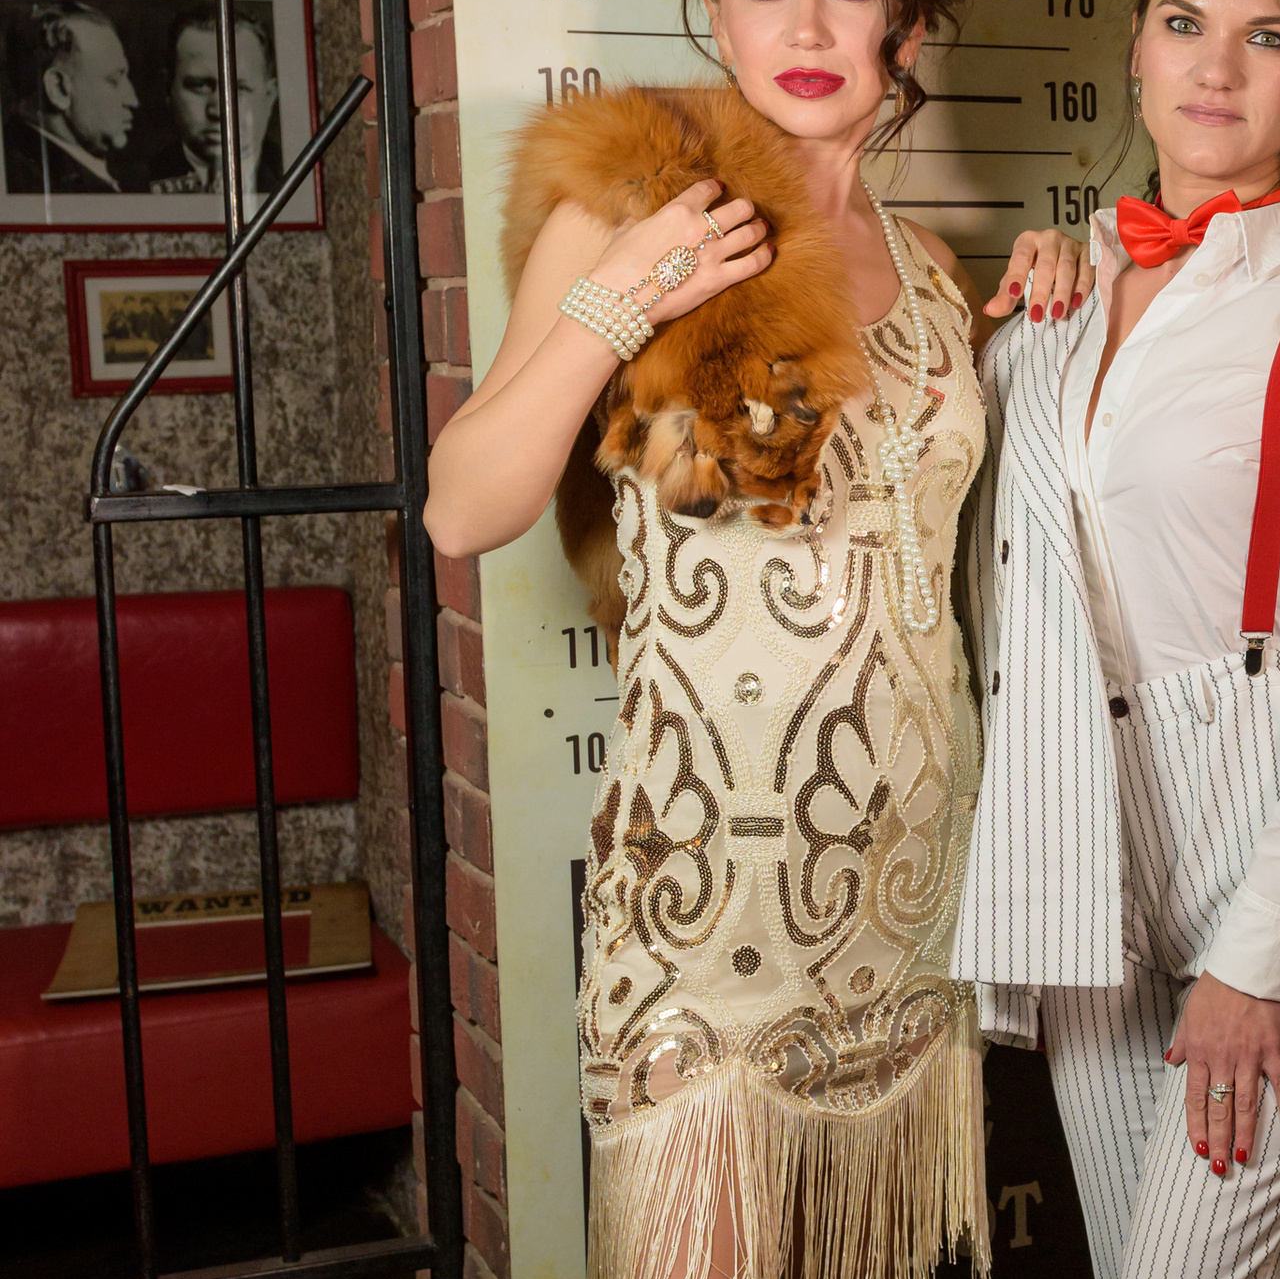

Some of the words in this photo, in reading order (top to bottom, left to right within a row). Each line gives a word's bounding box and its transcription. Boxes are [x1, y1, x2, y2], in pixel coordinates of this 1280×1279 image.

[1044, 80, 1098, 123] 160
[1046, 184, 1100, 226] 150
[561, 625, 612, 669] 11
[565, 732, 611, 775] 10
[137, 890, 312, 915] WANTD
